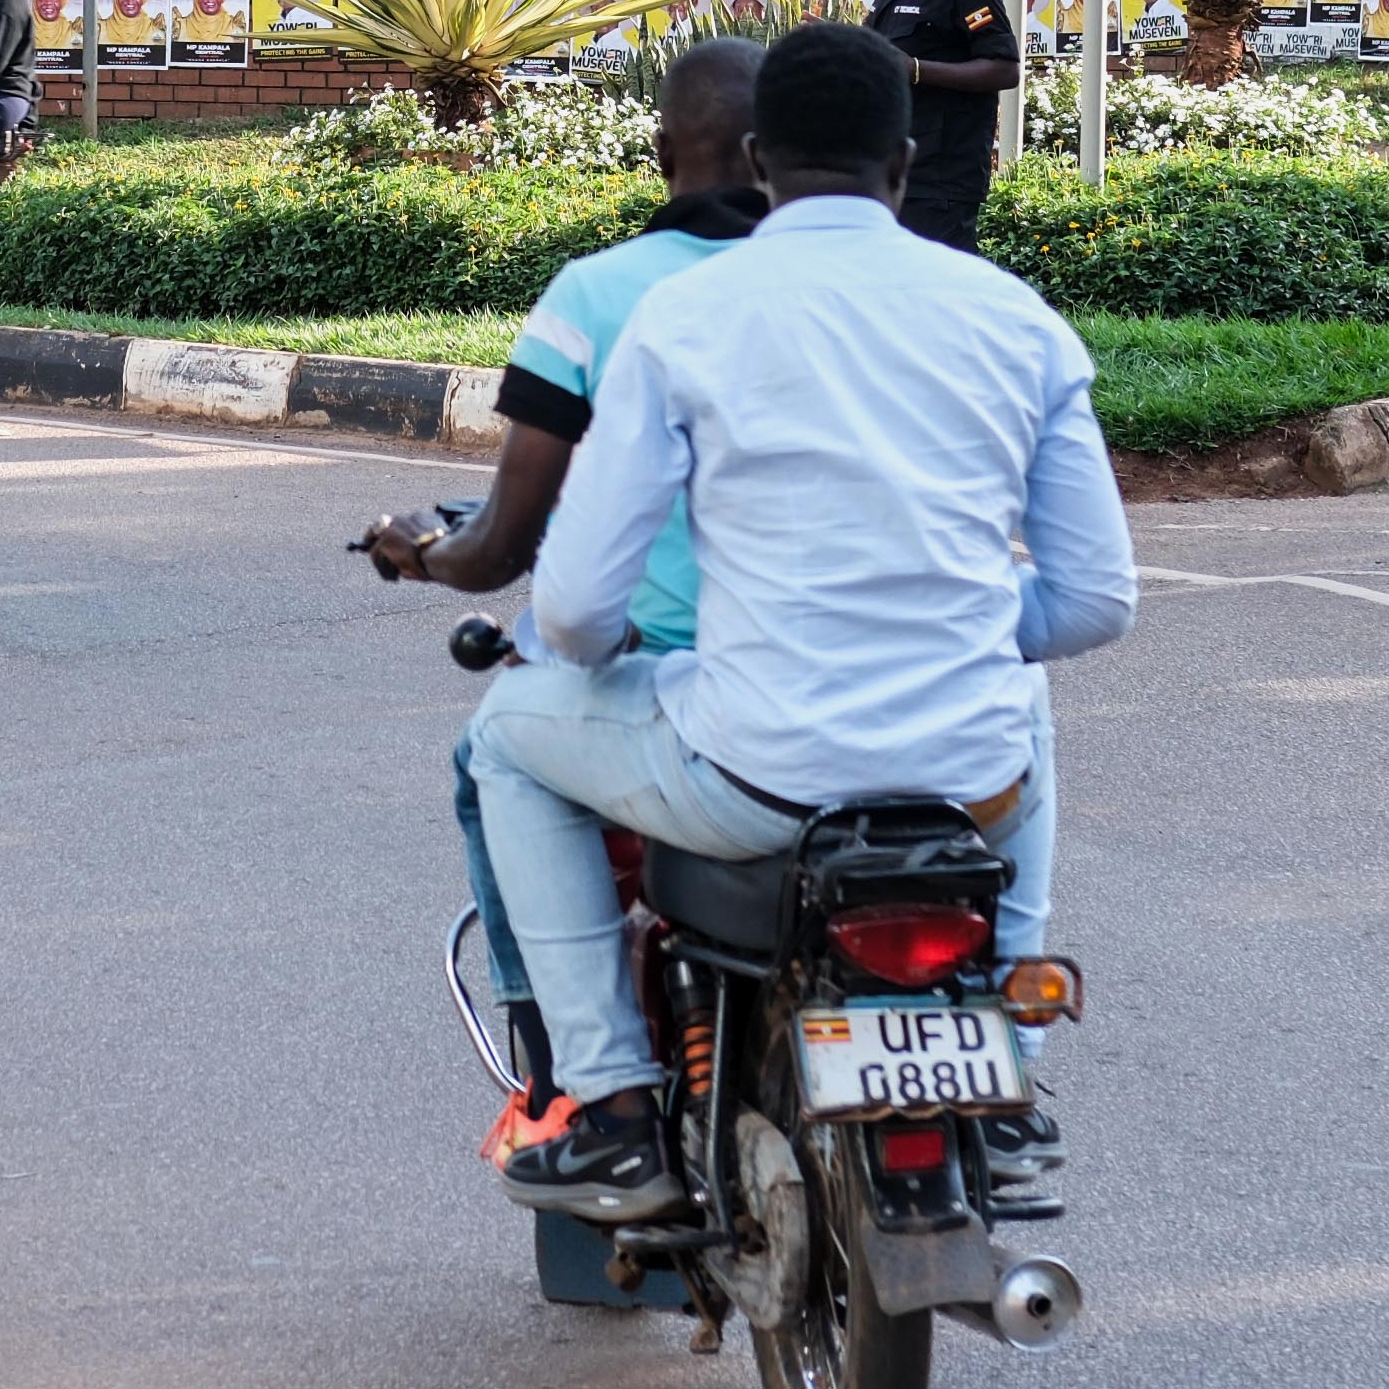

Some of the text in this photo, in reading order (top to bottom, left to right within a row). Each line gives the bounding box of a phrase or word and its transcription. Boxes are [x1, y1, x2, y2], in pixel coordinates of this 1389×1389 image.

[1134, 15, 1174, 28] YOWERI
[1129, 26, 1181, 40] MUSEVENI
[580, 45, 626, 60] YOWERI
[1026, 43, 1047, 54] VENI
[1280, 43, 1326, 55] MUSEVENI
[572, 57, 627, 69] MUSEVEN
[878, 1013, 985, 1053] UFD
